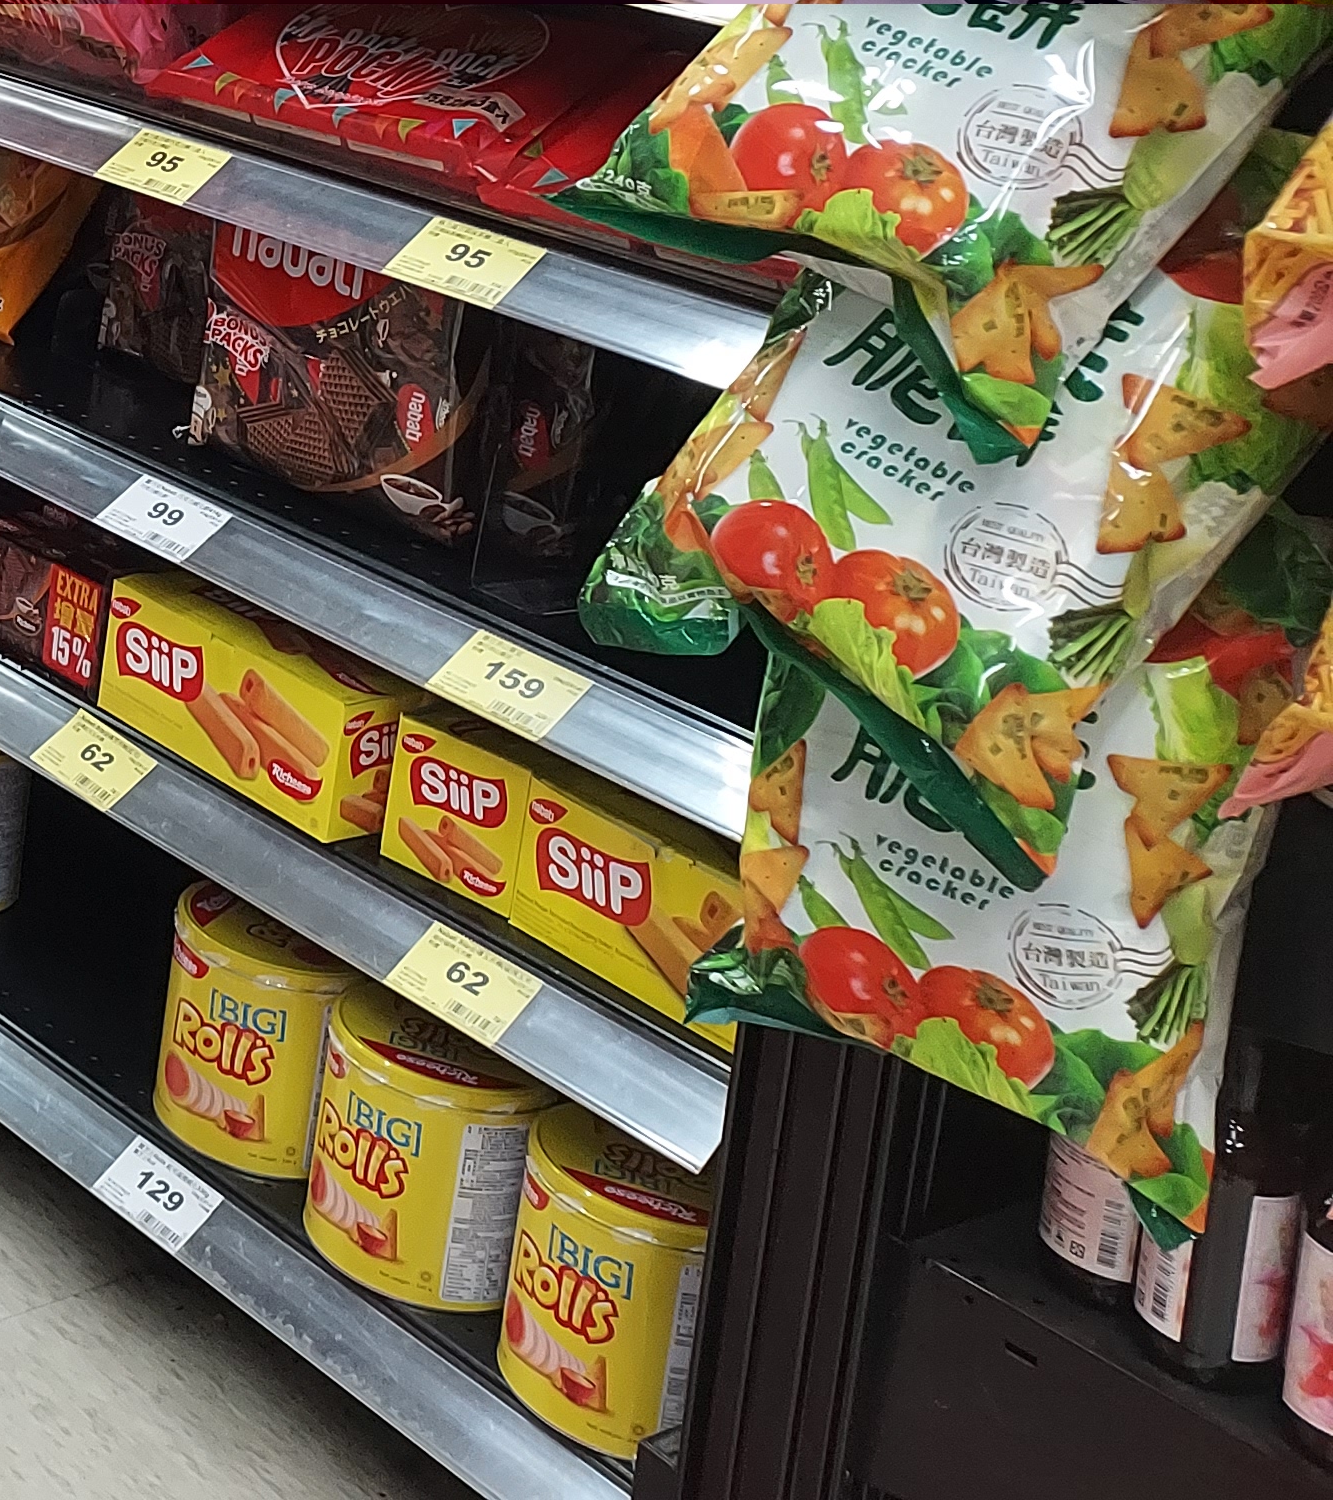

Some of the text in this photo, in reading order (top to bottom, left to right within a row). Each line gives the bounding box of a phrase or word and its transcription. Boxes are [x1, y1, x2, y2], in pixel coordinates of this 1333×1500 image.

[860, 38, 961, 90] cracker
[864, 13, 995, 80] vegetable
[145, 151, 184, 175] 95
[444, 243, 493, 269] 95
[209, 326, 263, 372] PACKS
[210, 312, 269, 349] BONUS
[406, 390, 425, 443] nabati
[839, 440, 946, 501] cracker
[844, 416, 976, 495] vegetable
[146, 502, 185, 527] 99
[960, 535, 1051, 579] 台灣製造
[56, 570, 99, 611] EXTRA
[50, 625, 92, 680] 15%
[126, 627, 198, 694] SiiP
[484, 658, 545, 698] 159
[79, 742, 114, 773] 62
[420, 762, 503, 819] SiiP
[546, 838, 645, 916] SiiP
[873, 833, 1016, 902] vegetable
[877, 856, 993, 912] cracker
[446, 959, 491, 997] 62
[1020, 938, 1111, 970] 台灣製造
[172, 999, 276, 1087] Roll's
[317, 1098, 410, 1199] Roll's
[134, 1167, 185, 1215] 129
[516, 1229, 620, 1345] Roll's
